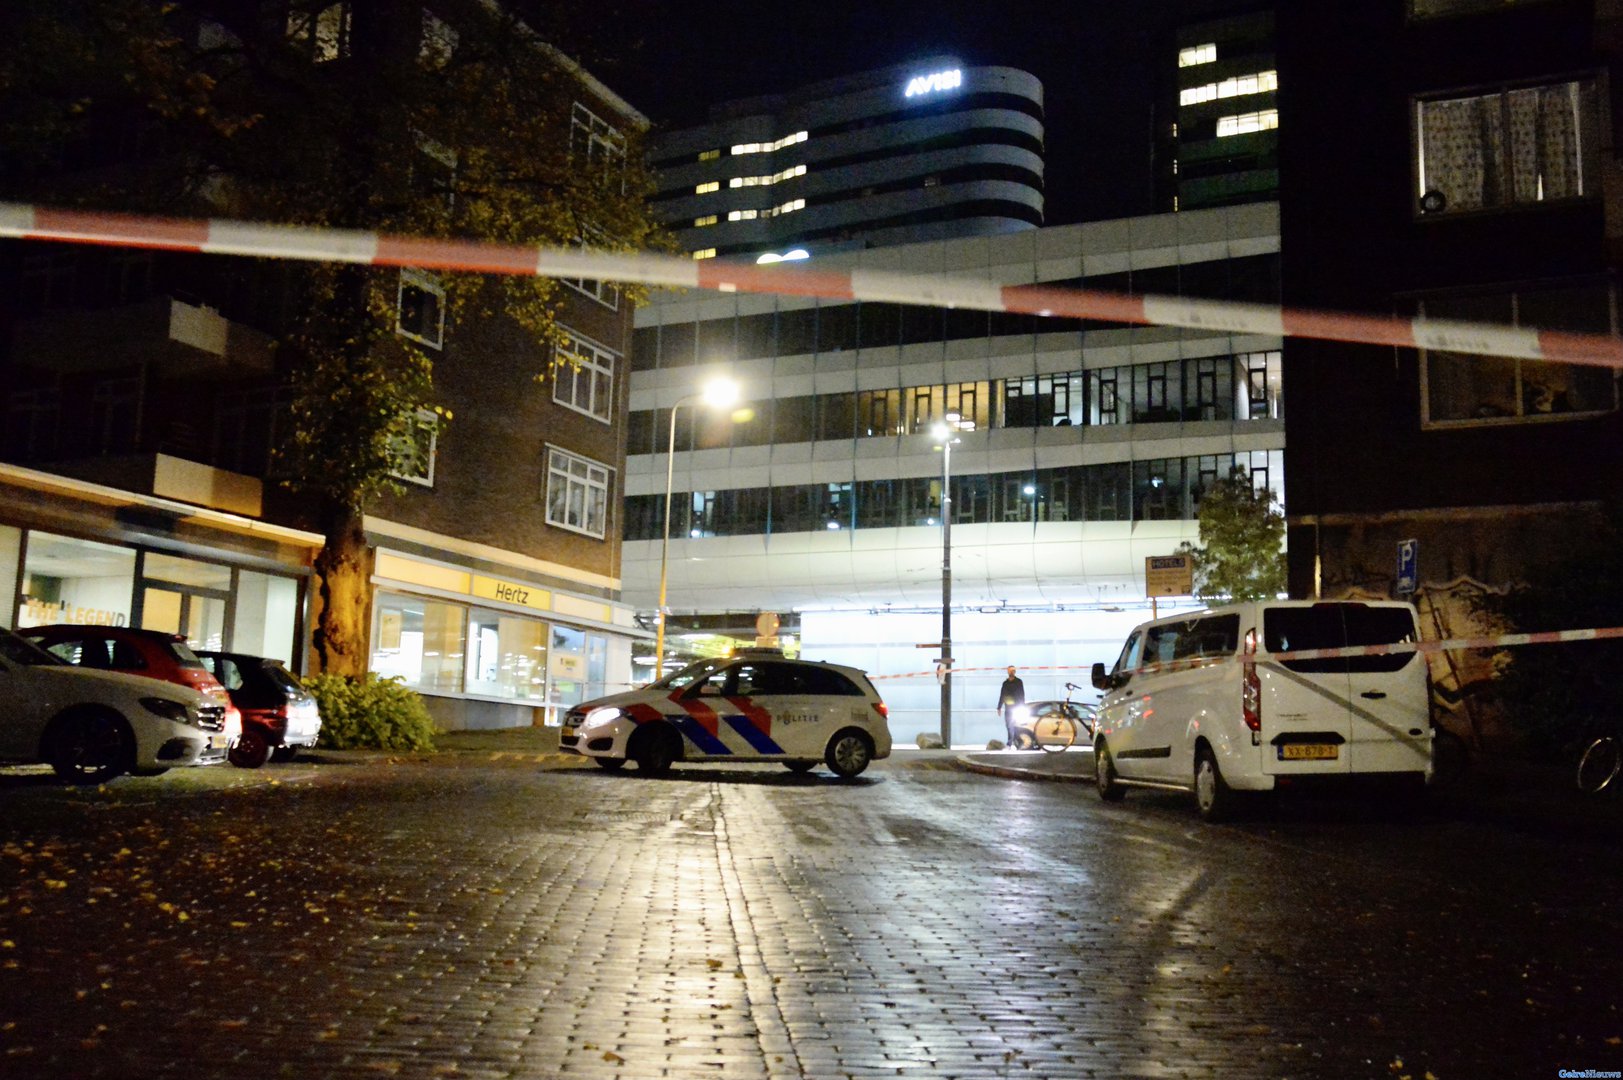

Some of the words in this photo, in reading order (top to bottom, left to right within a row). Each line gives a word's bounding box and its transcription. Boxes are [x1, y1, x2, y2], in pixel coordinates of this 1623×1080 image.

[905, 68, 961, 97] AVISI
[1152, 559, 1185, 569] HOTELS
[1401, 544, 1413, 571] P
[495, 583, 529, 604] Hertz
[65, 605, 126, 627] LEGEND
